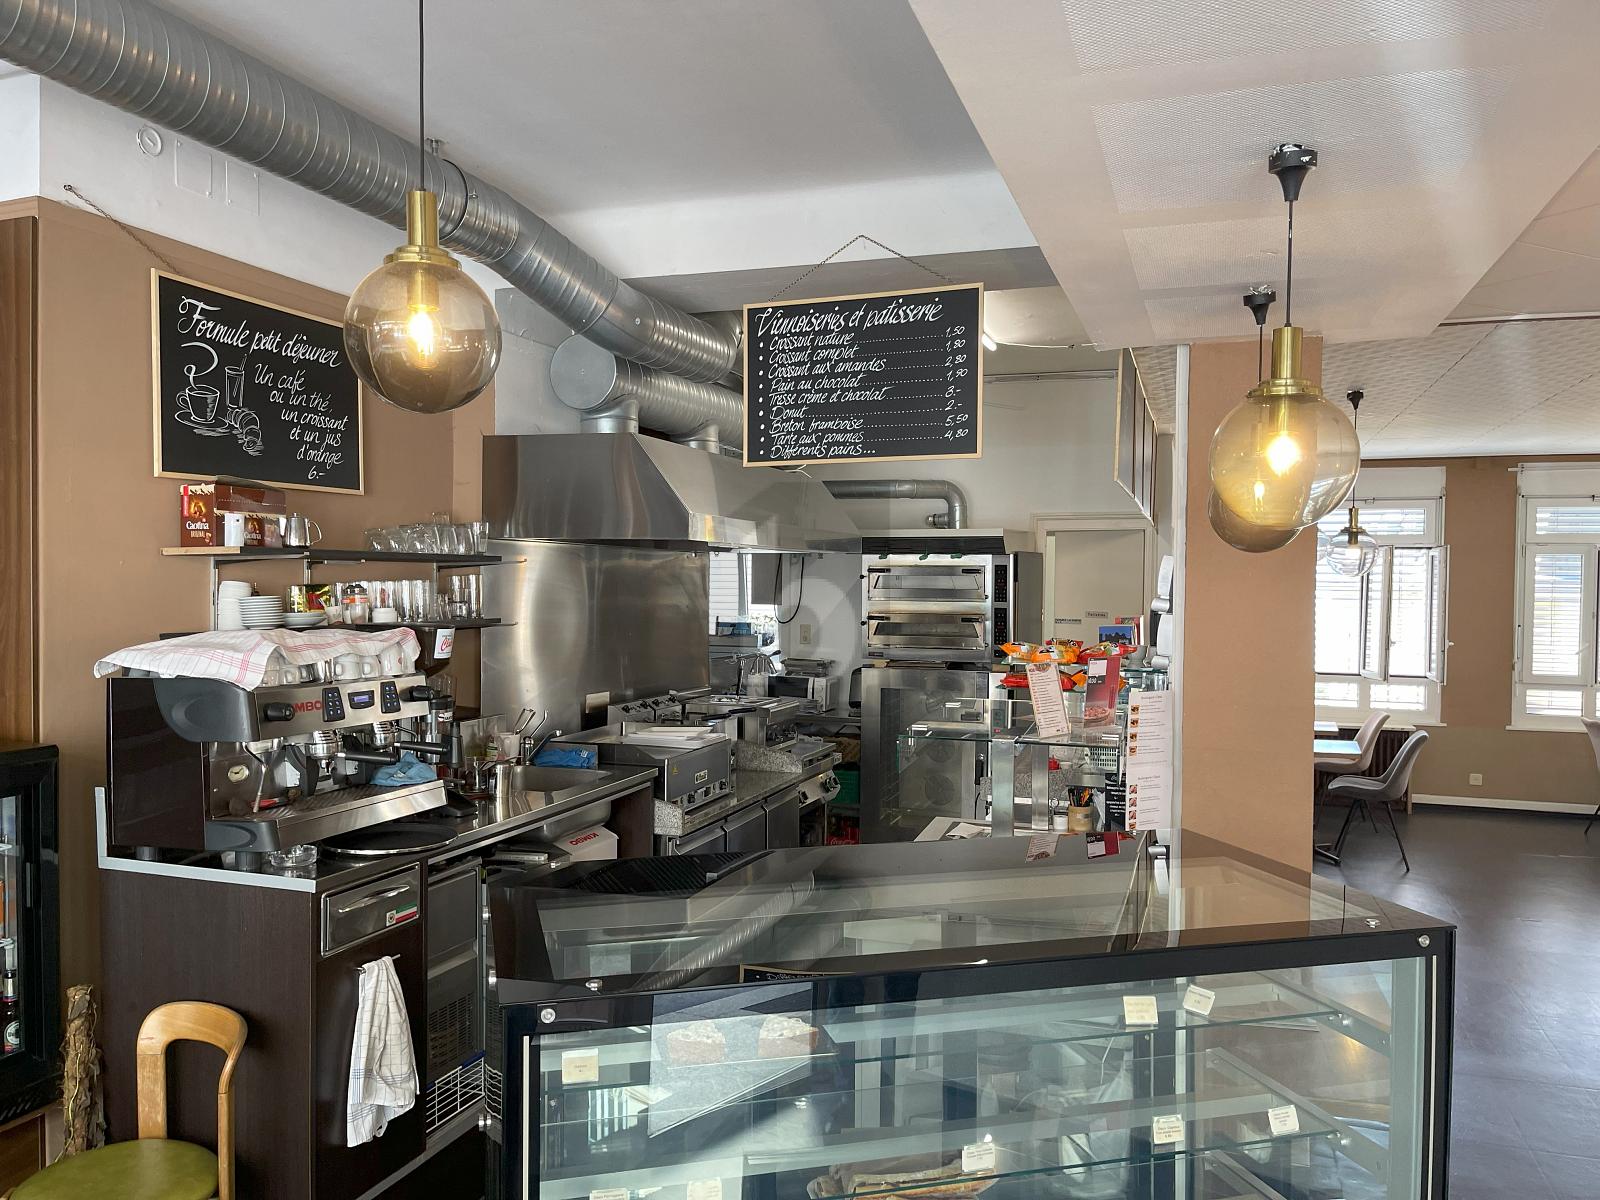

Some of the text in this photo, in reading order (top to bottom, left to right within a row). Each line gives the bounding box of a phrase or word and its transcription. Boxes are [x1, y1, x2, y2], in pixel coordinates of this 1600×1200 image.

[177, 296, 342, 368] Formule petit déjeuner
[754, 307, 850, 338] Viennoiseries
[848, 303, 867, 328] et
[769, 325, 966, 351] Croissant nature 1,50
[768, 345, 813, 364] Croissant
[812, 343, 860, 364] complet
[254, 363, 306, 392] Un café
[767, 354, 967, 379] Croissant aux amandes 2,80
[769, 377, 796, 393] Pain
[796, 379, 813, 390] au
[814, 372, 868, 390] chocolat
[269, 389, 333, 414] ou un thé,
[768, 391, 797, 407] Tresse
[797, 388, 828, 404] crème
[829, 389, 843, 403] et
[840, 385, 896, 402] chocolat
[280, 408, 349, 431] un croissant
[769, 405, 810, 420] Donut
[769, 413, 969, 434] Breton framboise 5,50
[289, 425, 342, 451] et un jus
[771, 428, 969, 446] Tarte aux pommes 4,80
[296, 444, 344, 470] d'orange
[769, 443, 828, 460] Différents
